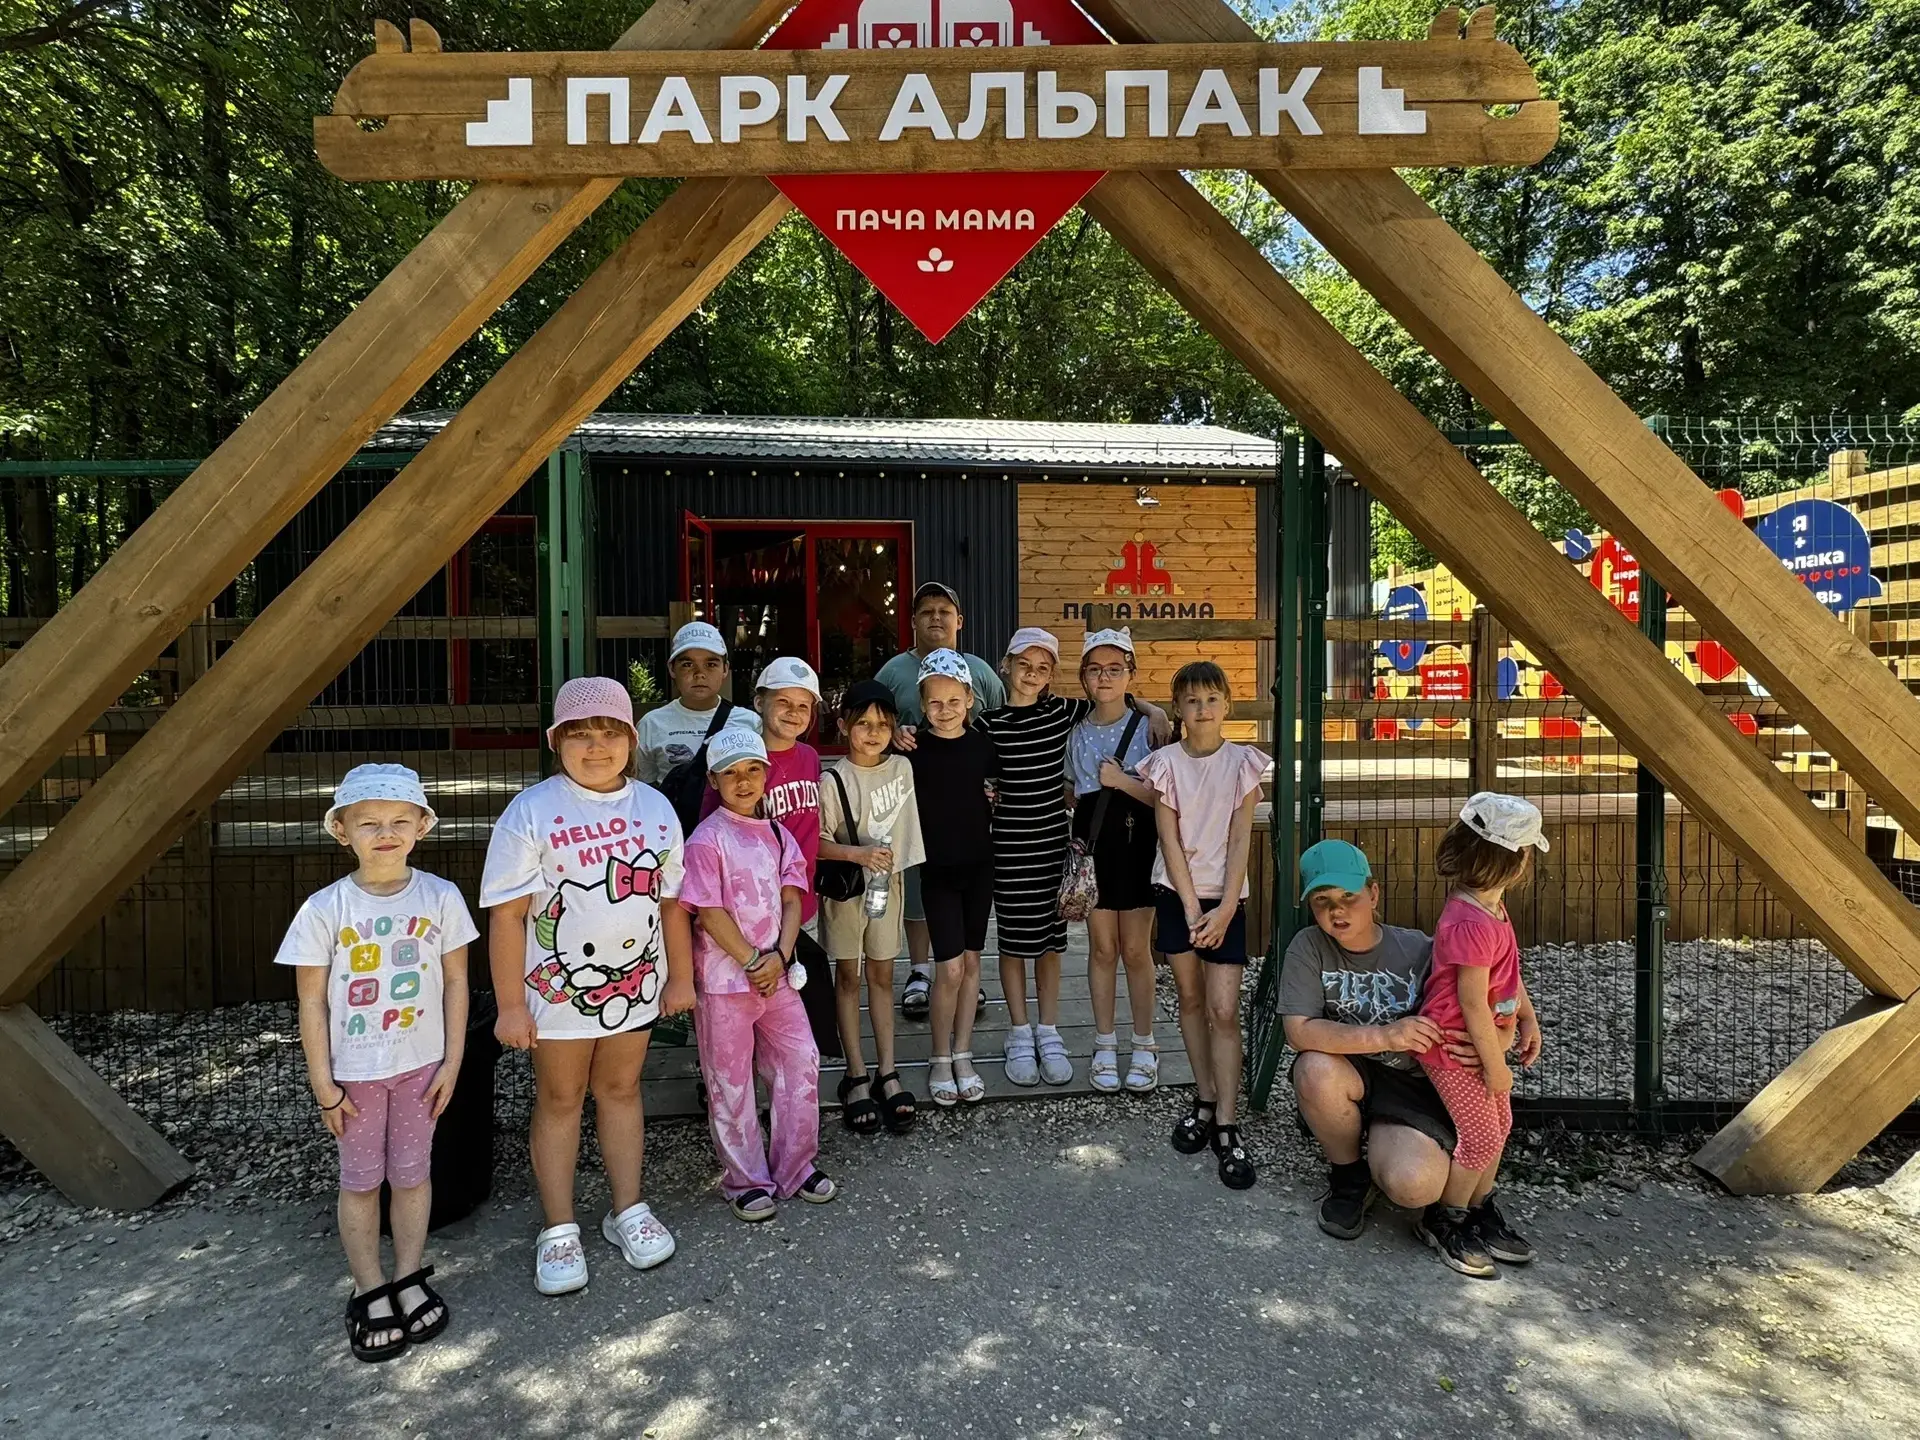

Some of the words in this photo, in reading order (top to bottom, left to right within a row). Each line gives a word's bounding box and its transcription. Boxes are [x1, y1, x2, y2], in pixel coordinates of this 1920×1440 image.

[567, 75, 850, 144] ПАРК
[878, 67, 1324, 140] АЛЬПАК
[836, 209, 925, 231] ПАЧА
[935, 209, 1035, 231] МАМА
[1792, 515, 1808, 533] Я
[1781, 549, 1845, 570] ьпака
[1063, 602, 1132, 619] ПАА
[1139, 602, 1215, 619] МАМА
[721, 733, 754, 747] meow
[870, 775, 905, 817] NIKE
[550, 818, 627, 849] HELLO
[579, 834, 645, 867] KITTY
[339, 914, 441, 948] AVORITE
